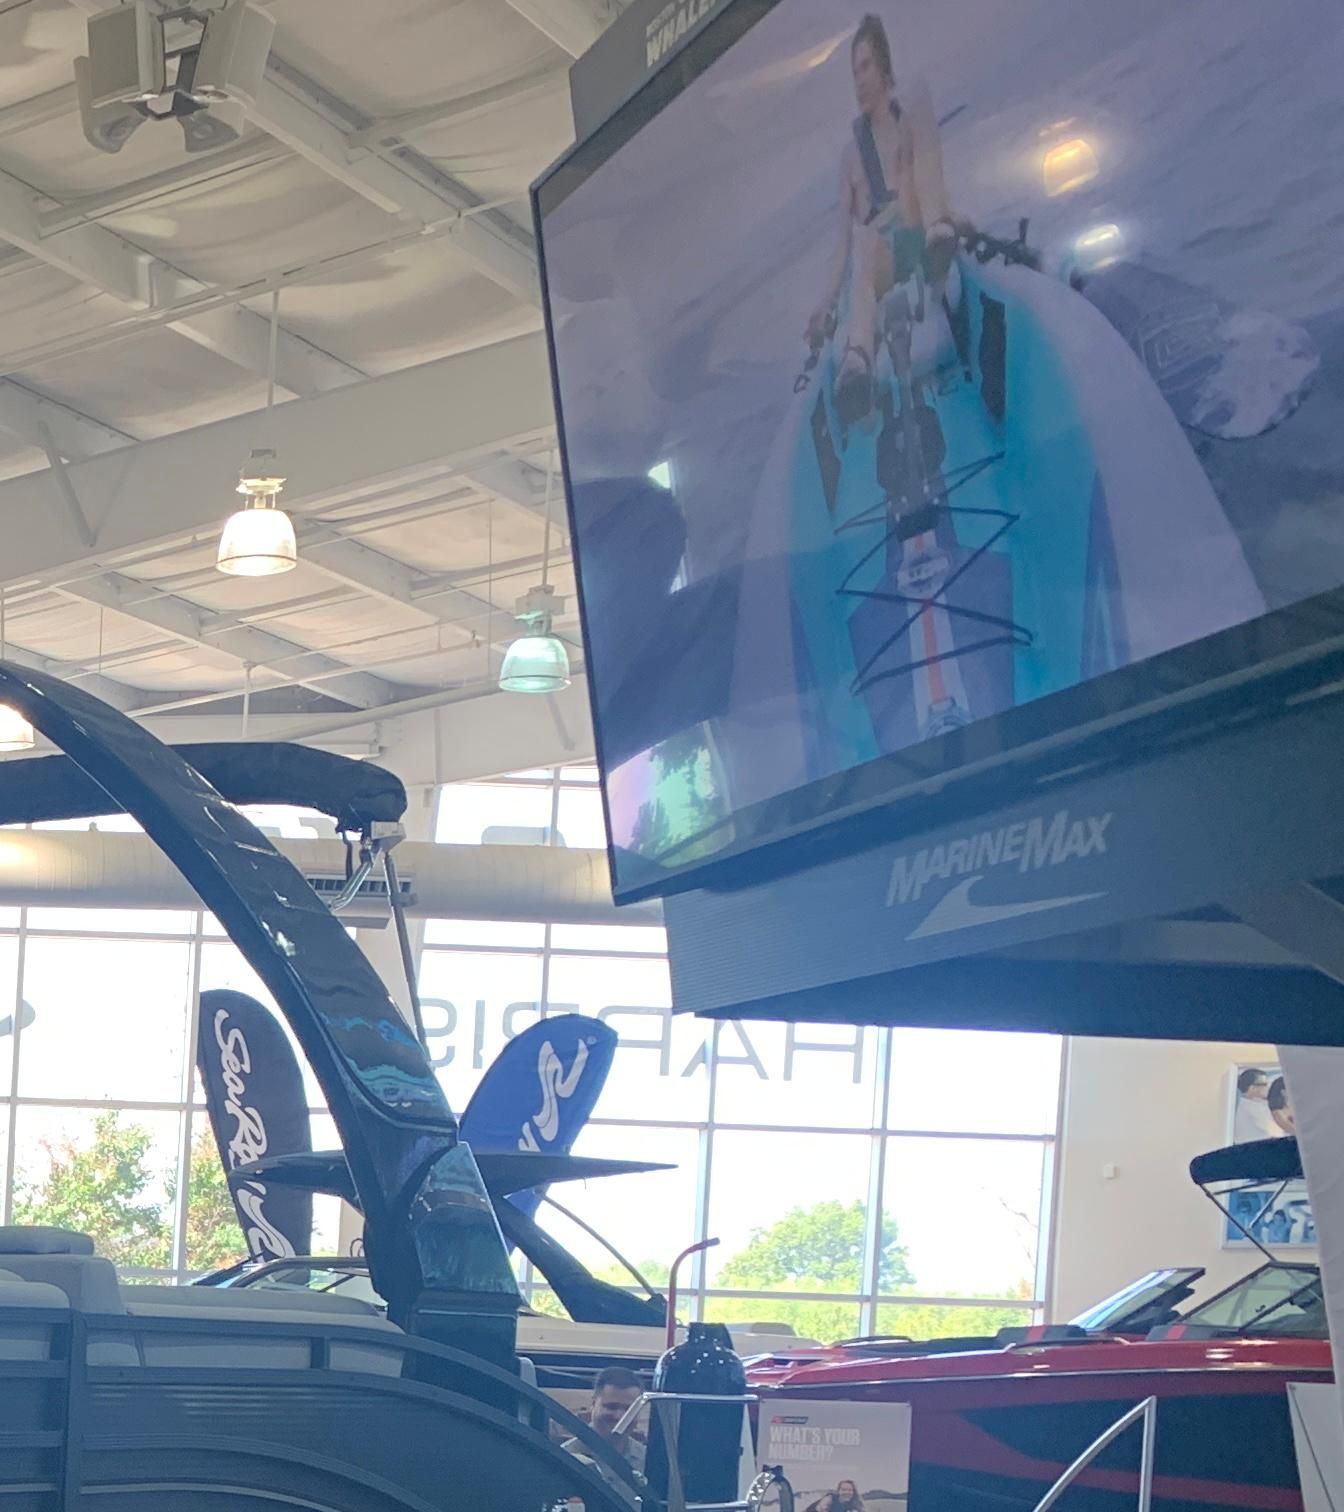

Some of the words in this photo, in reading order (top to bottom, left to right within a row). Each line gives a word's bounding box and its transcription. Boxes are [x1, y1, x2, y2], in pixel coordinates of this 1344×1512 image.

[645, 0, 715, 68] WHALE
[769, 1425, 821, 1445] WHAT'S
[823, 1427, 861, 1446] YOUR
[768, 1443, 834, 1461] NUMBER?
